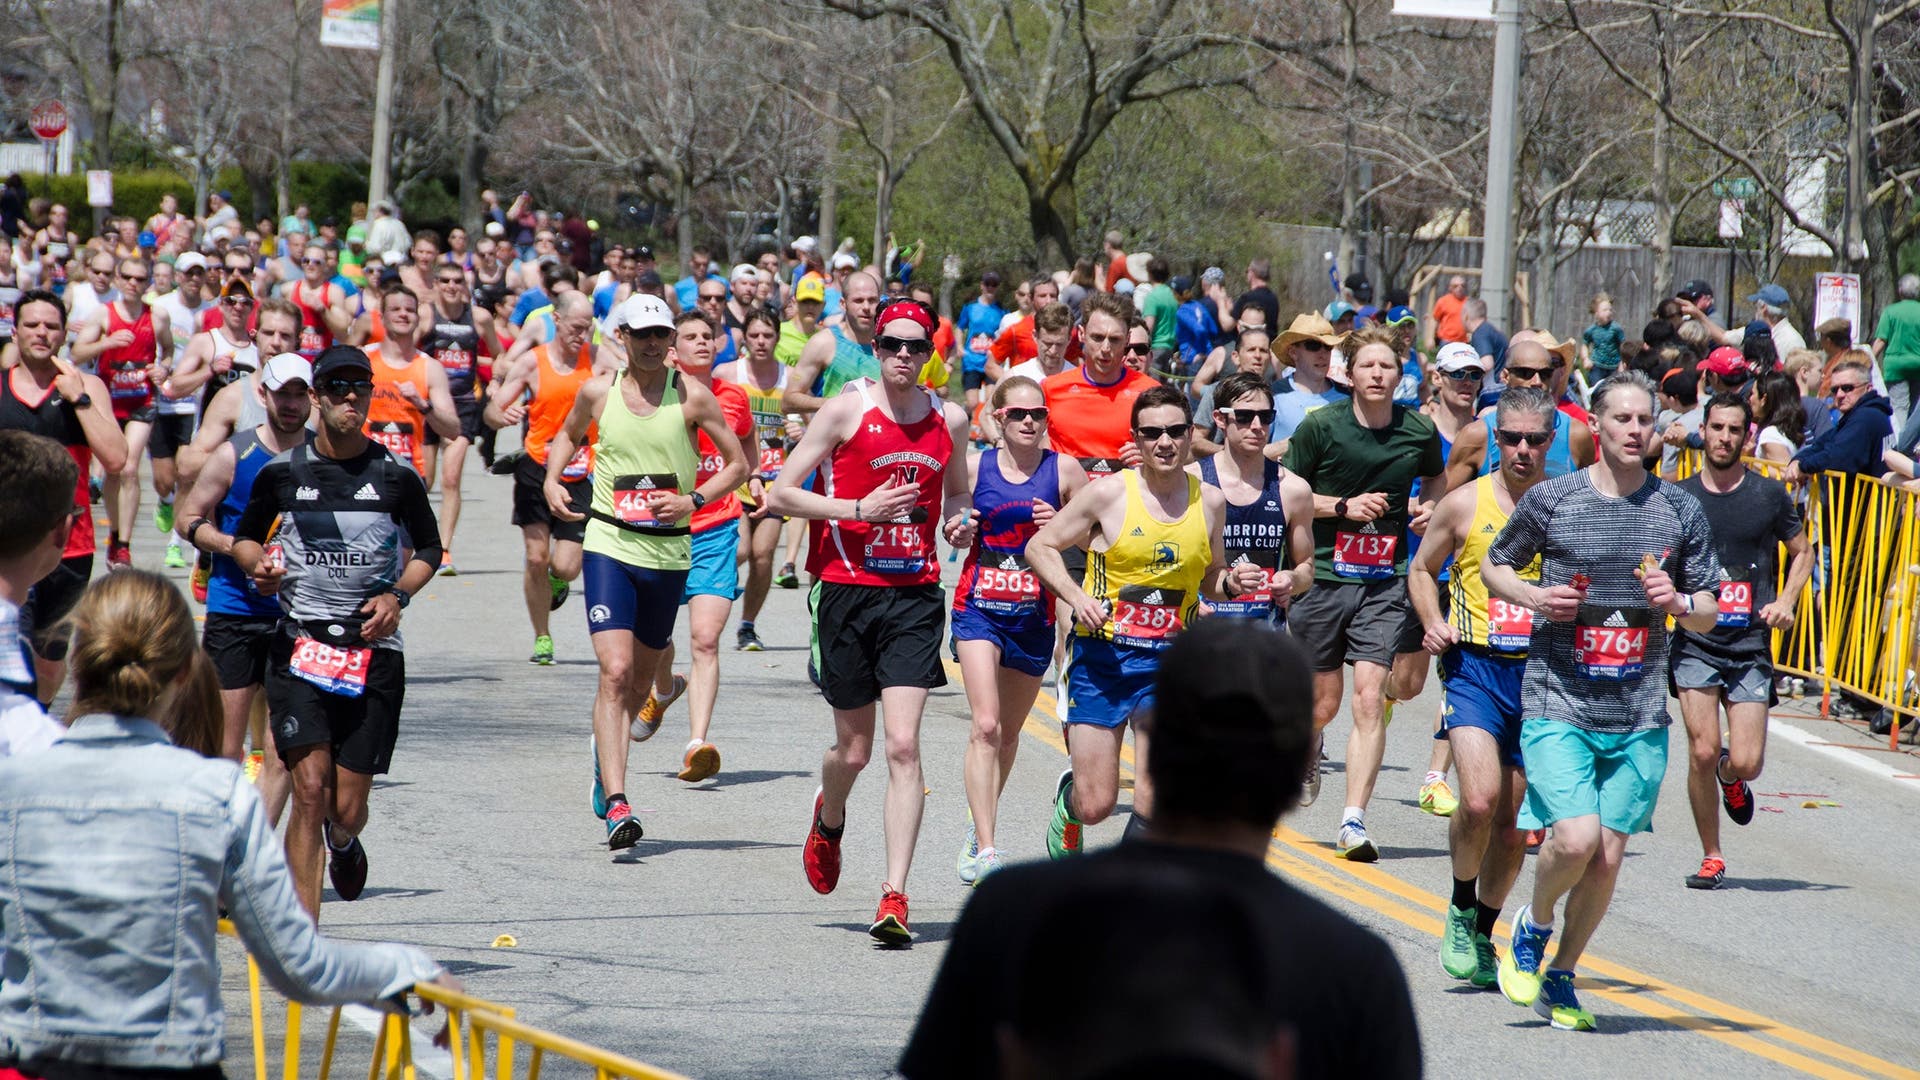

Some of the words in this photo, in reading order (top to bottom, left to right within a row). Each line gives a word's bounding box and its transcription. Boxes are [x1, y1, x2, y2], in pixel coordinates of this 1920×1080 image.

[31, 112, 65, 130] STOP
[438, 350, 468, 362] 5963
[870, 451, 942, 472] NORTHEASTERN
[871, 526, 920, 546] 2156
[865, 546, 872, 555] 3
[1342, 535, 1393, 556] 7137
[305, 553, 371, 566] DANIEL
[1335, 551, 1342, 560] 8
[328, 568, 349, 578] COL
[982, 570, 1034, 592] 5503
[1721, 584, 1748, 603] 60
[1121, 604, 1176, 628] 2387
[1114, 622, 1121, 633] 3
[1583, 629, 1643, 654] 5764
[300, 641, 362, 670] 6853
[1576, 650, 1583, 661] 6
